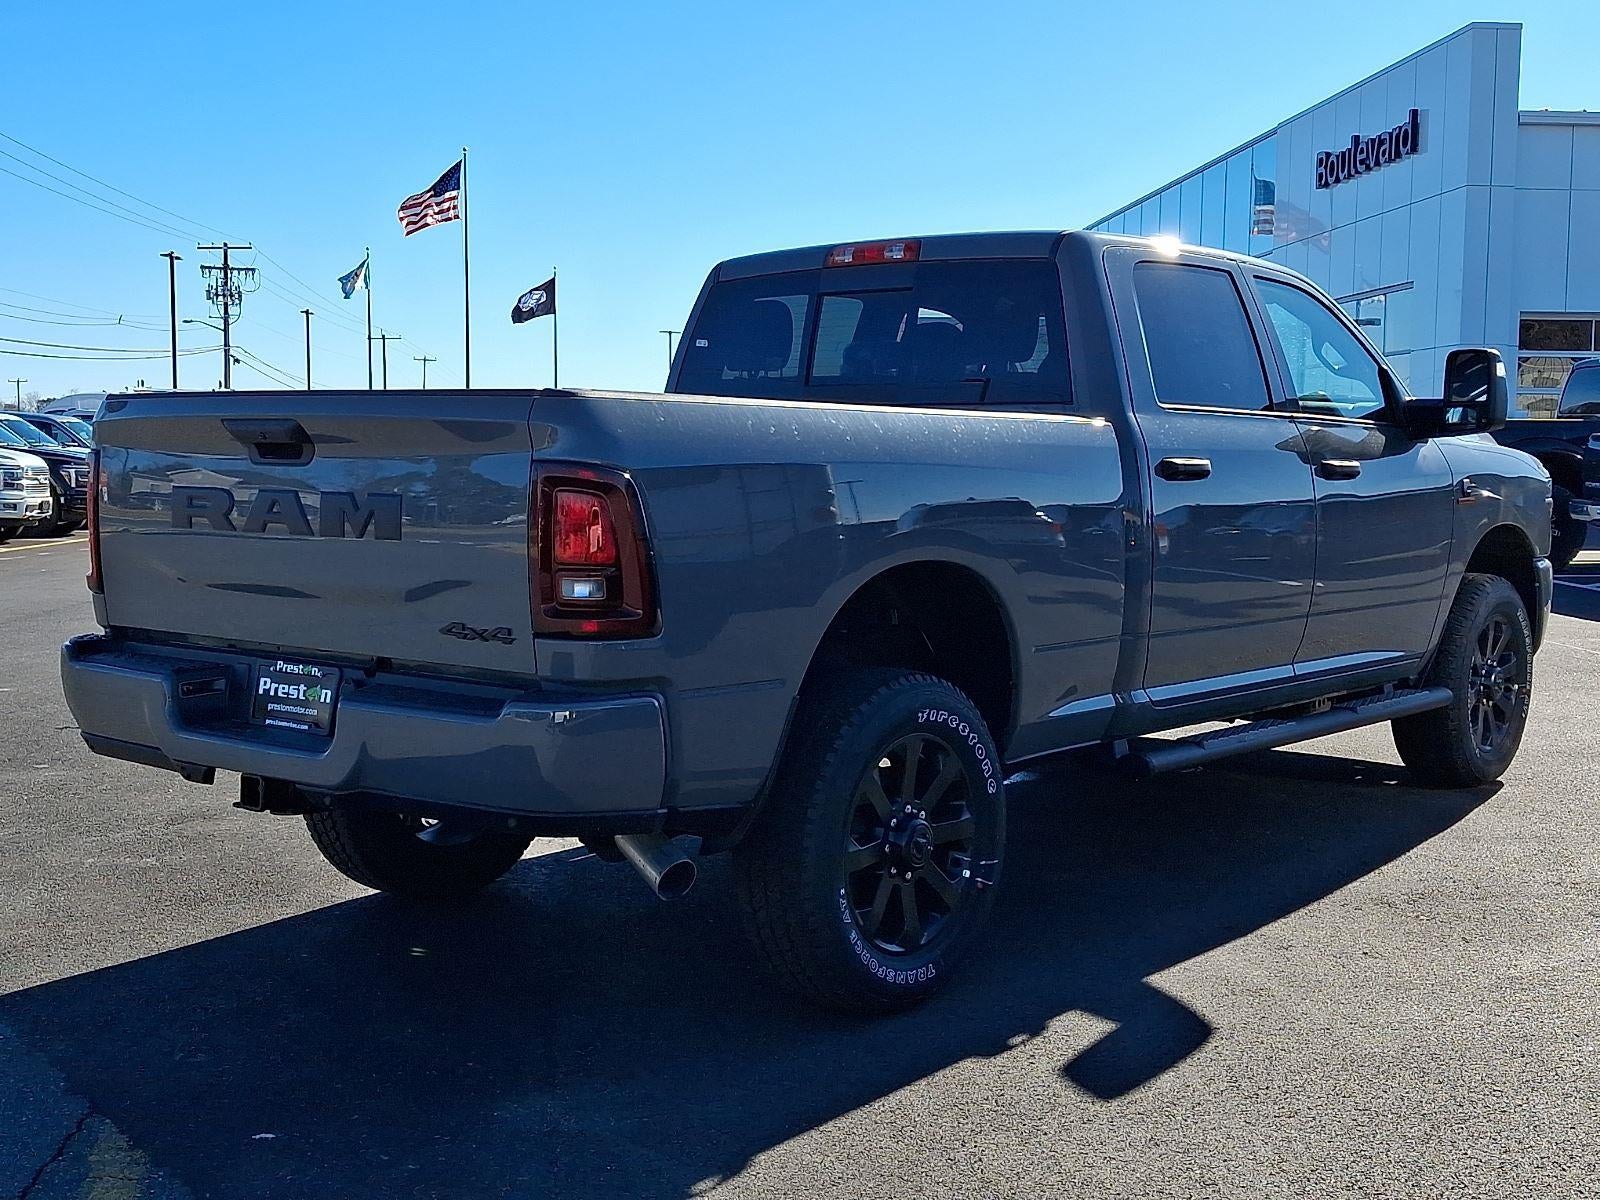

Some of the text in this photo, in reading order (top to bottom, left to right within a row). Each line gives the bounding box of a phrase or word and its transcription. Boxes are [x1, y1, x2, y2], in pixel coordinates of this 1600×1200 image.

[1315, 108, 1420, 190] Boulevard
[171, 485, 402, 541] RAM
[258, 677, 332, 704] Preston
[276, 660, 319, 677] Preston
[267, 703, 318, 716] prestonmotor.com
[918, 708, 997, 794] Firestone
[849, 929, 936, 984] TRANSFORCE
